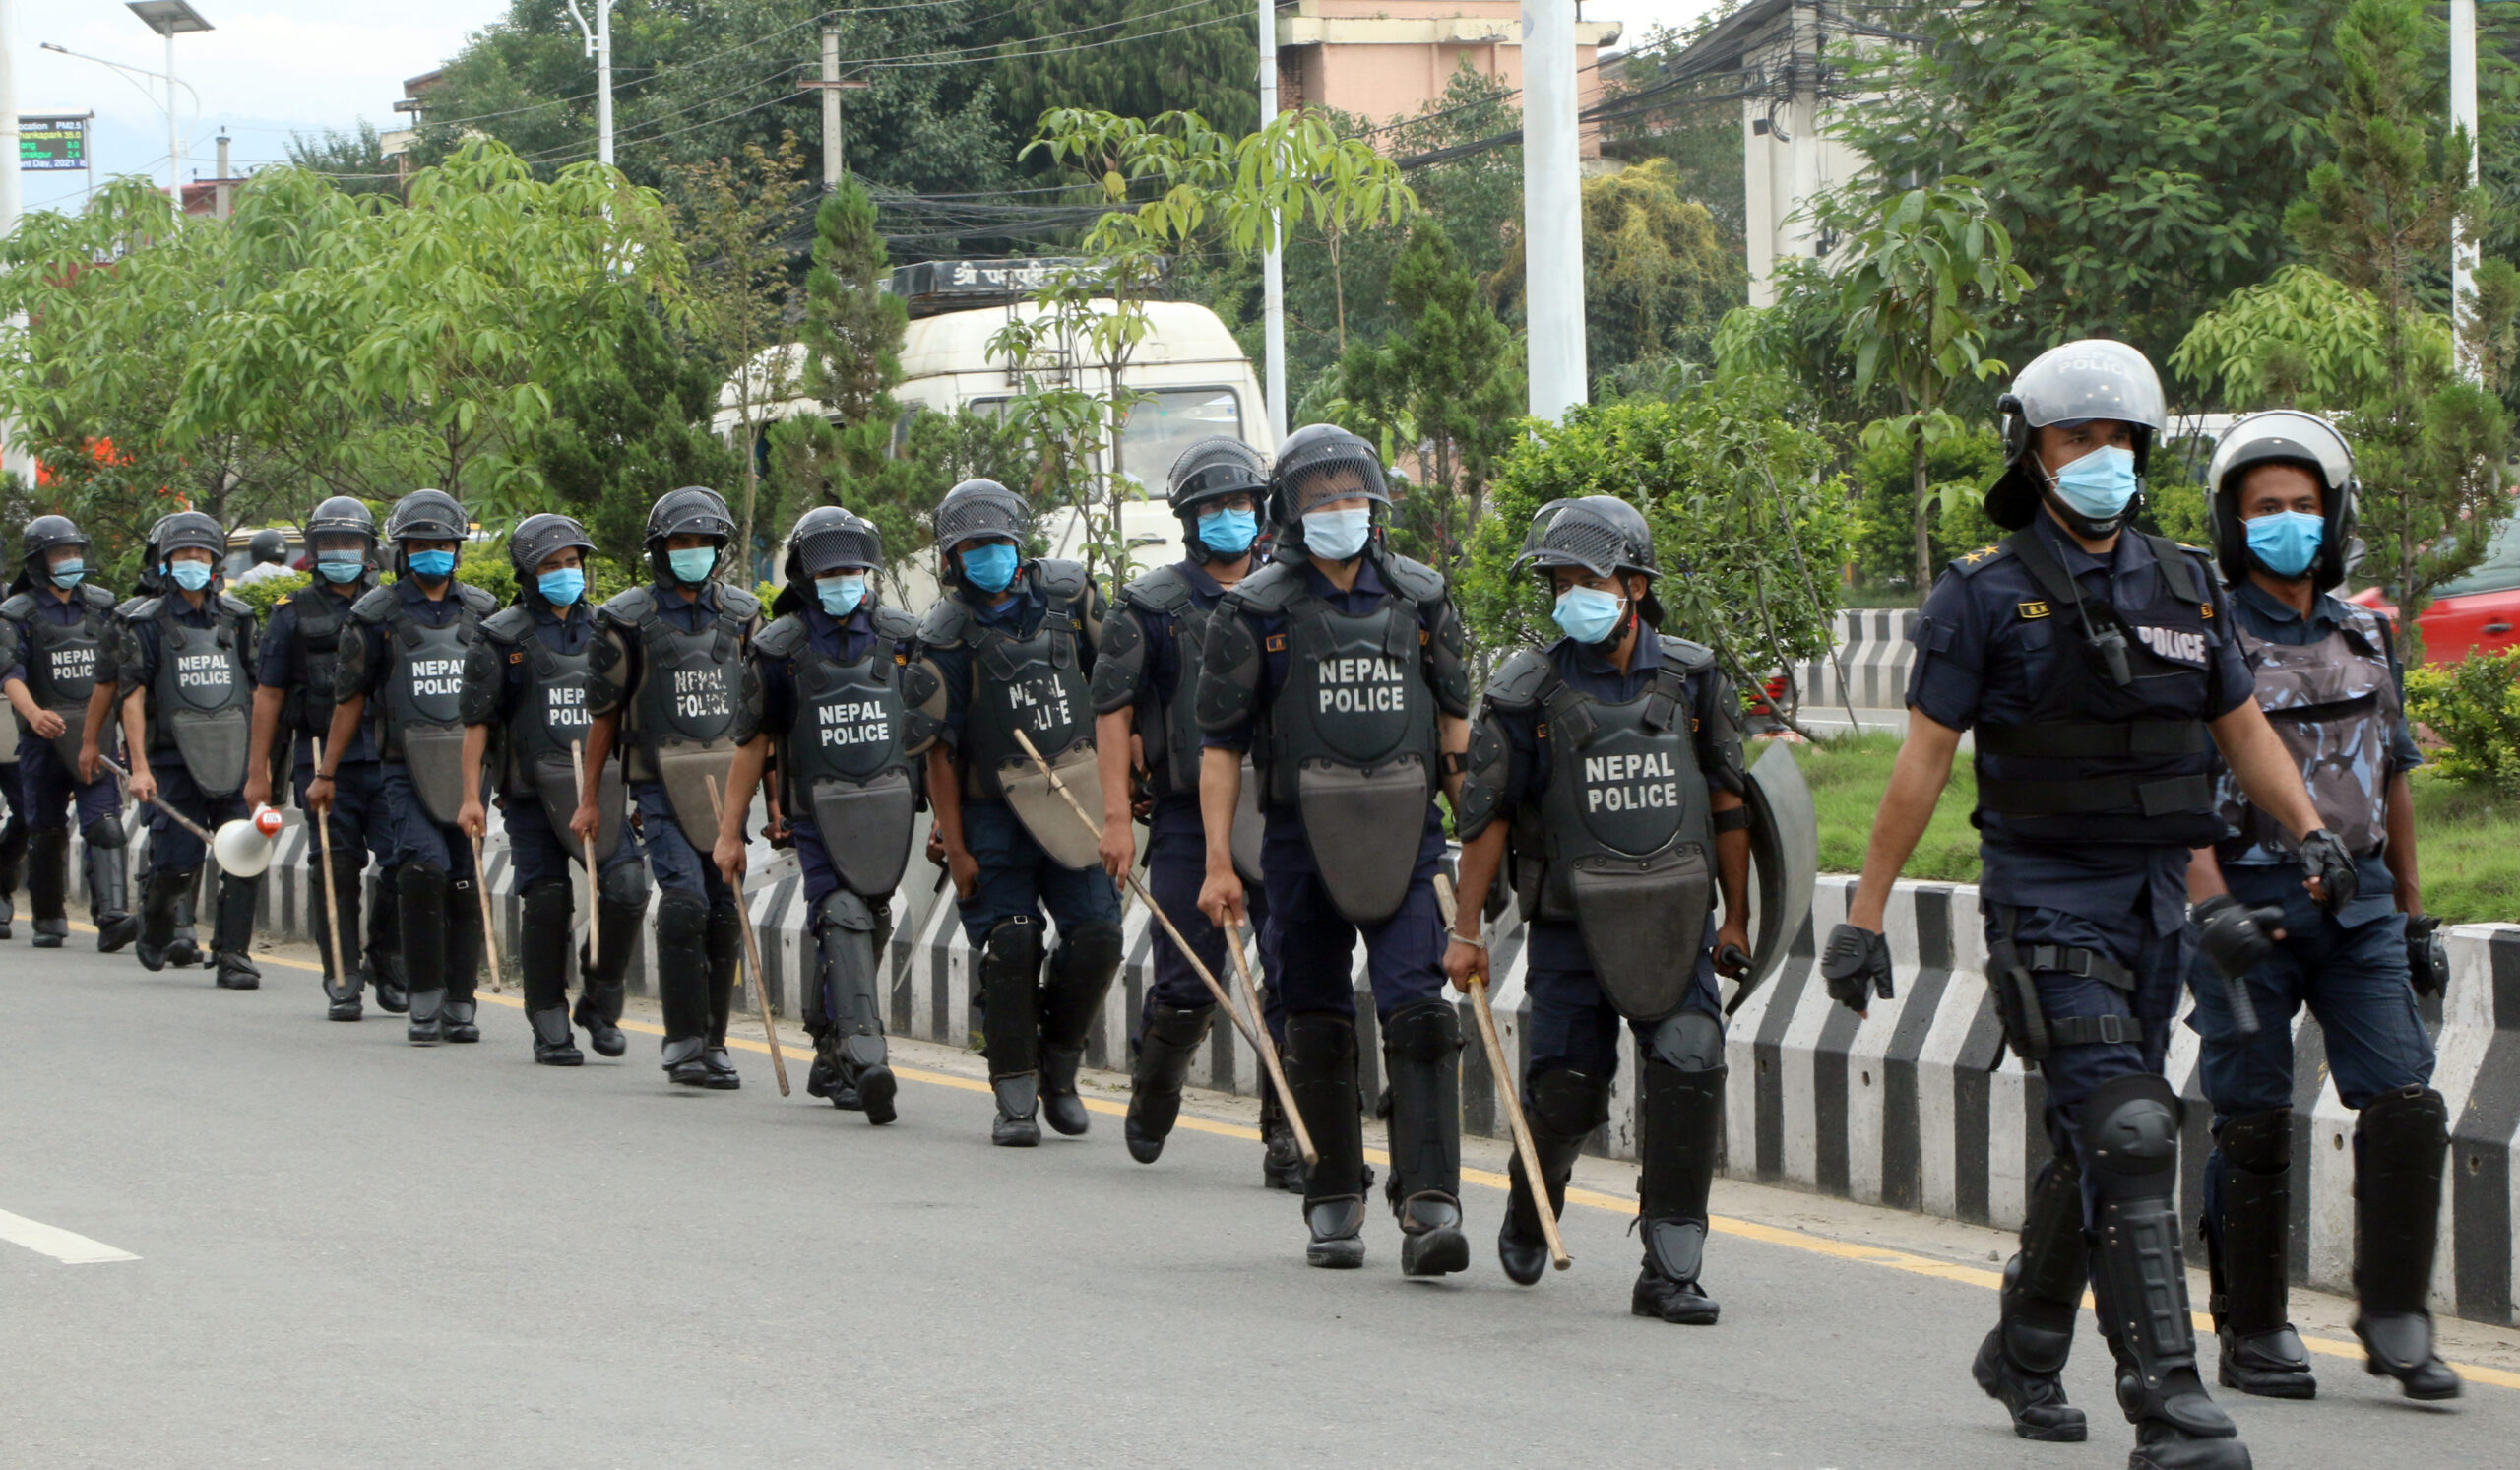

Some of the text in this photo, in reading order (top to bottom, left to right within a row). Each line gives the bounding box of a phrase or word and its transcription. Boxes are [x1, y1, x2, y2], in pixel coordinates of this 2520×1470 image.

[54, 159, 75, 167] 2021
[2058, 358, 2135, 382] POLIC
[2137, 626, 2207, 663] POLICE
[53, 664, 94, 680] POLIC
[178, 655, 229, 671] NEPAL
[1318, 657, 1404, 684] NEPAL
[180, 671, 232, 687] POLICE
[413, 677, 463, 696] POLIC
[548, 687, 586, 705] NEP
[1319, 686, 1405, 714] POLICE
[549, 708, 594, 726] POLI
[818, 700, 887, 725] NEPAL
[821, 723, 890, 747] POLICE
[1585, 752, 1676, 783] NEPAL
[1588, 783, 1678, 813] POLICE
